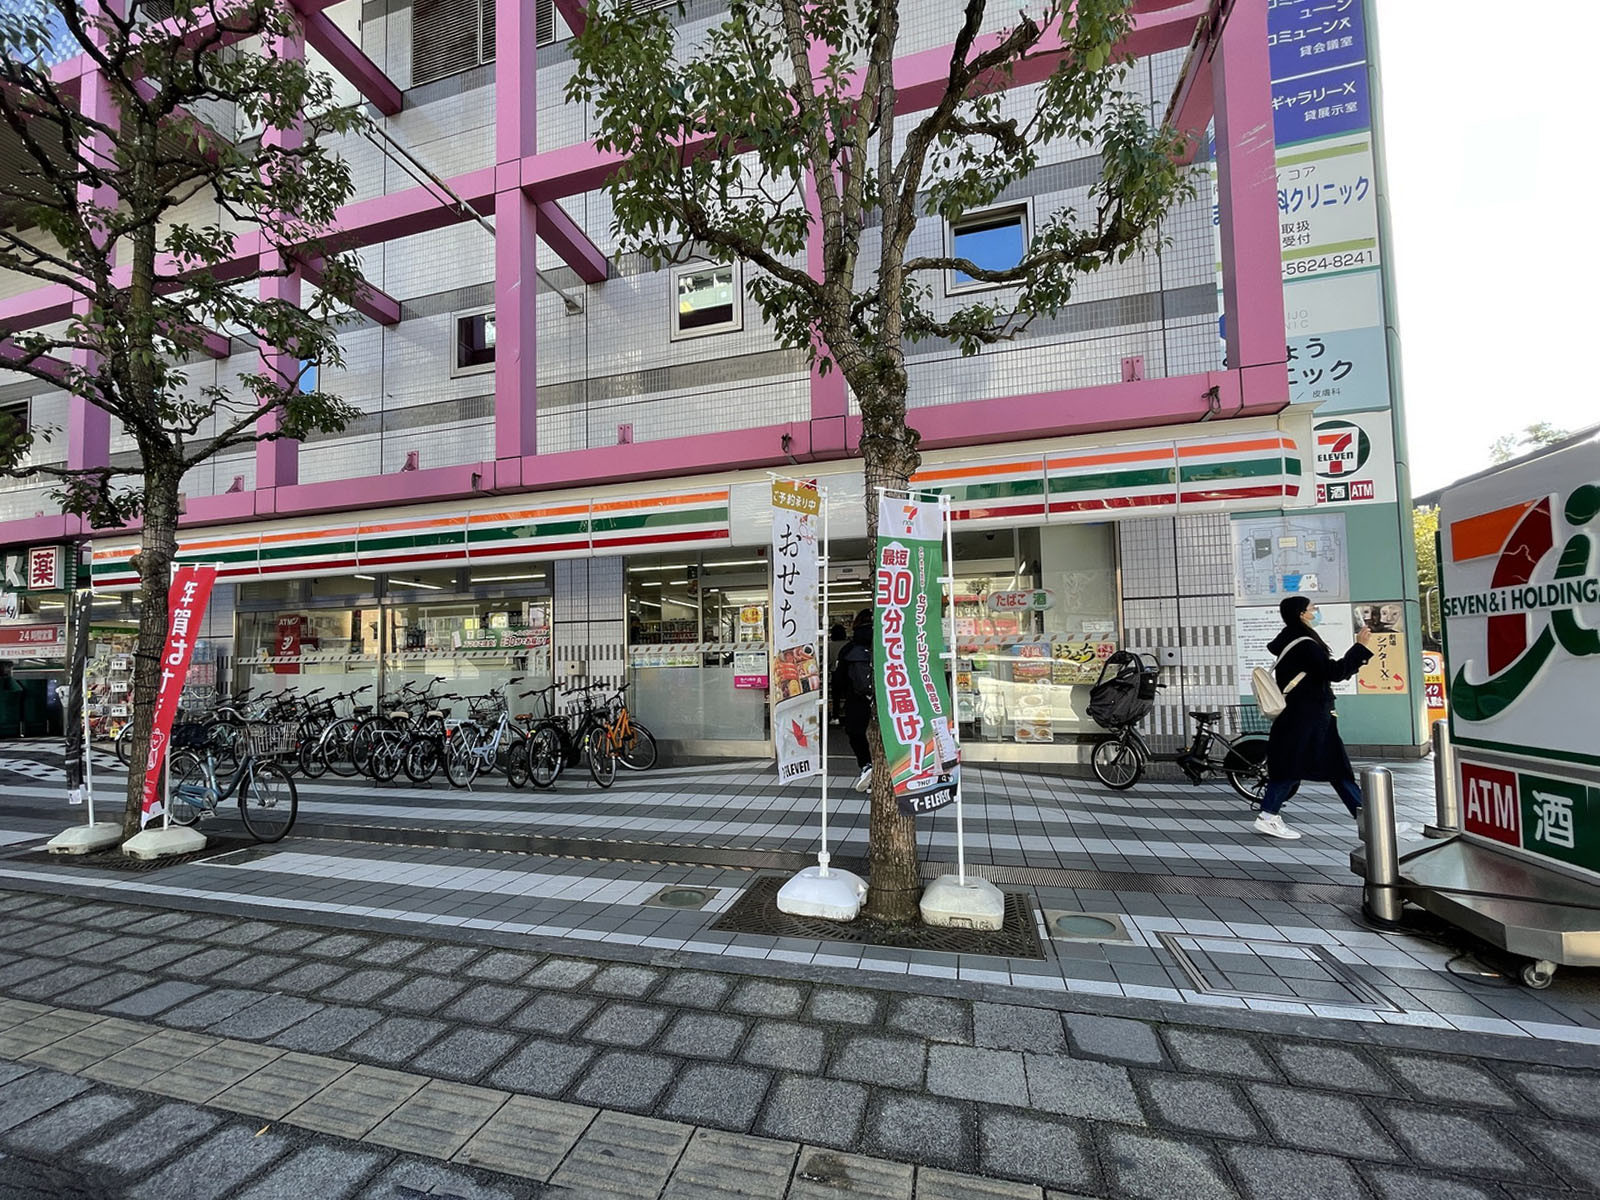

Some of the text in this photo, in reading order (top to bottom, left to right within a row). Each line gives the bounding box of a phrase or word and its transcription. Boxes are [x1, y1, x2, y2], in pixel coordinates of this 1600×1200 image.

[1299, 36, 1353, 57] 貸会議室
[1271, 80, 1356, 110] ギャラリーX
[1304, 101, 1358, 121] 貸展示室
[1281, 221, 1310, 234] 取扱
[1282, 233, 1311, 248] 受付
[1329, 485, 1346, 500] 酒
[1351, 483, 1373, 498] ATM
[32, 552, 55, 585] 薬
[776, 523, 802, 639] おせち
[995, 592, 1047, 607] たばこ 酒
[1511, 577, 1600, 611] HOLDING
[1467, 777, 1575, 849] ATM 酒
